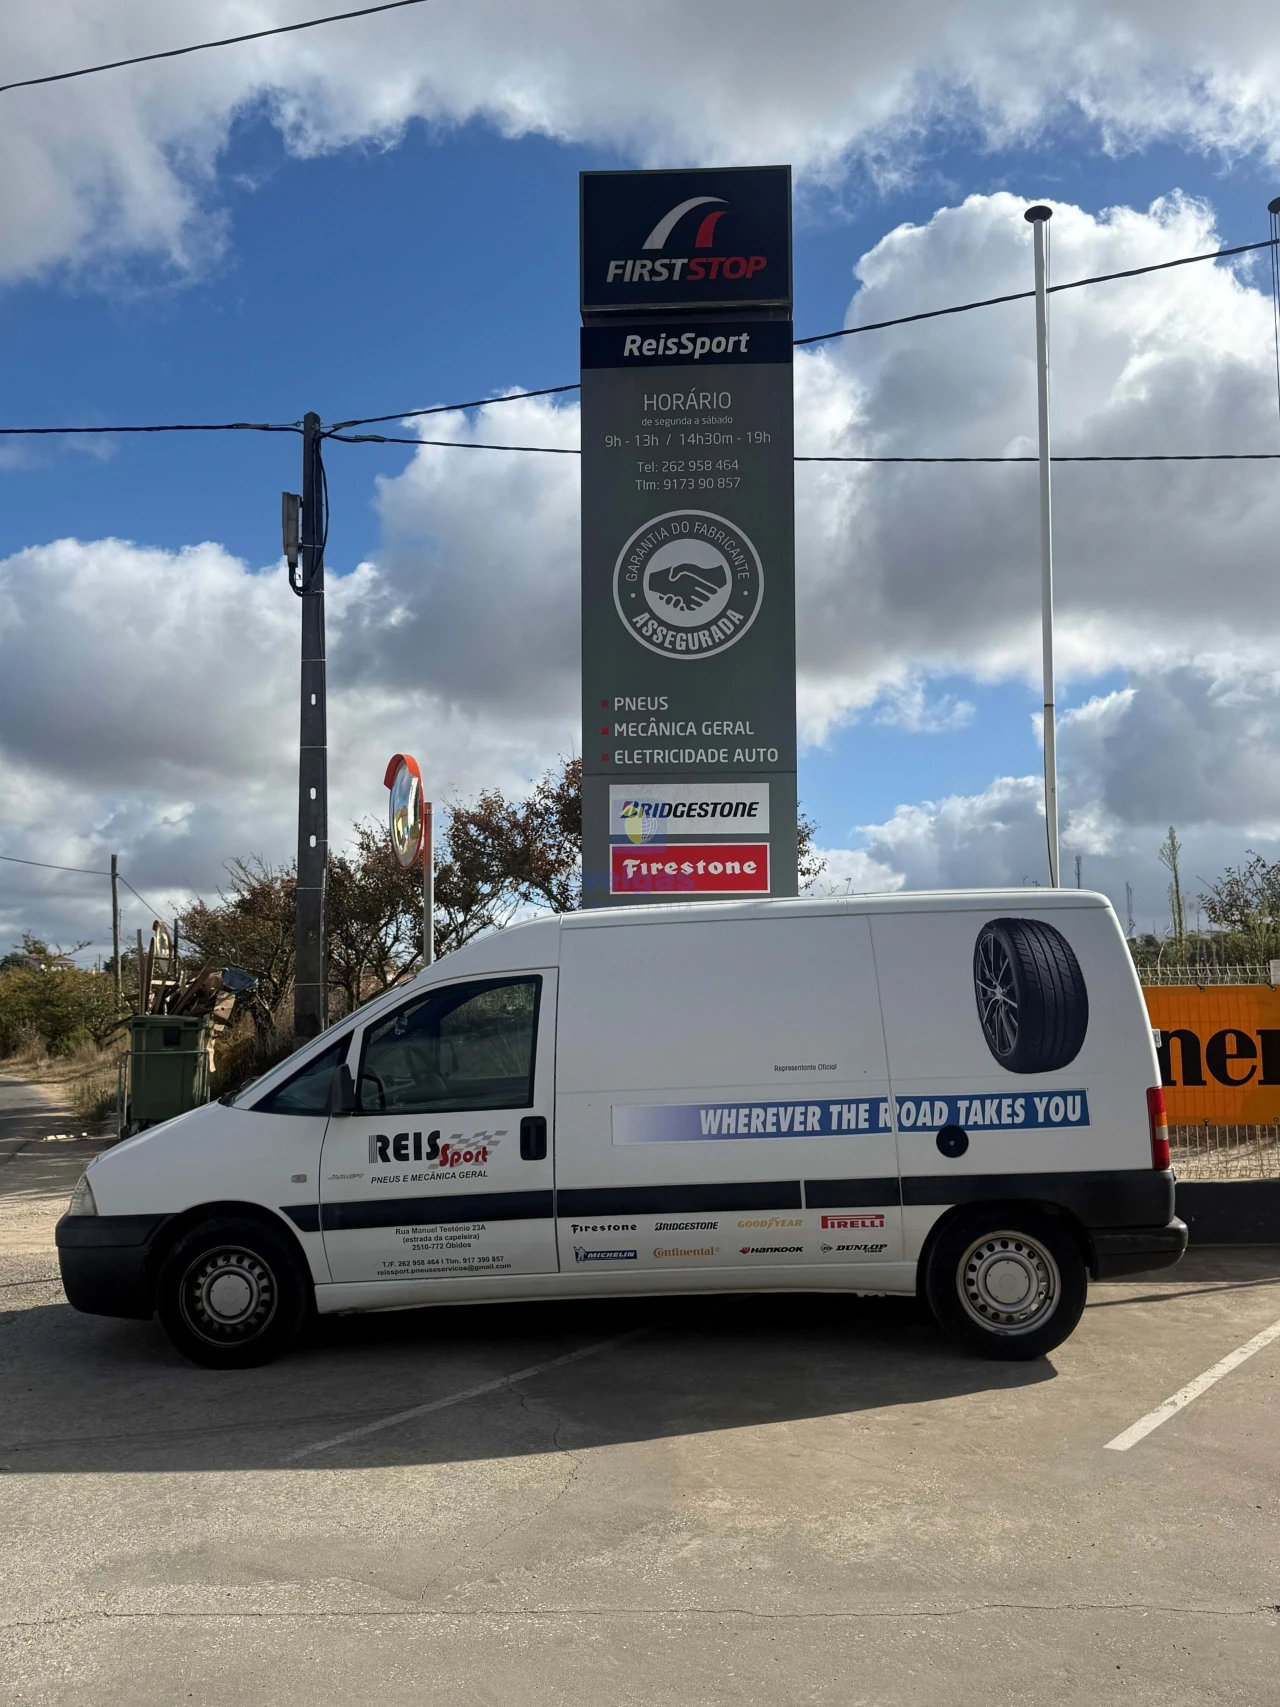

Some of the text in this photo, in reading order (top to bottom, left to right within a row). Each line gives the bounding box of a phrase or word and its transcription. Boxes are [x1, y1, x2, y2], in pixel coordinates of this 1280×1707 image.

[623, 332, 750, 359] ReisSport
[643, 387, 732, 412] HORÁRIO
[641, 415, 733, 428] de segunda a sábado
[604, 435, 622, 448] 9h
[634, 434, 659, 447] 13h
[665, 433, 672, 446] /
[679, 432, 733, 446] 14h30m
[746, 431, 771, 444] 19h
[636, 459, 739, 473] Tel: 262 958 464
[635, 477, 741, 491] Tlm: 9173 90 857
[625, 521, 750, 582] GARANTIA DO FABRICANTE
[632, 609, 745, 651] ASSEGURADA
[614, 696, 669, 711] PNEUS
[614, 717, 754, 737] MECÂNICA GERAL
[614, 748, 779, 764] ELETRICIDADE AUTO
[620, 800, 760, 819] BRIDGESTONE
[622, 858, 757, 880] Firestone
[774, 1063, 837, 1073] Representante Oficial
[700, 1095, 1082, 1135] WHEREVER THE ROAD TAKES YOU
[368, 1130, 441, 1164] REIS
[439, 1143, 489, 1168] Sport
[371, 1170, 489, 1184] PNEUS E MECÂNICA GERAL
[571, 1223, 637, 1234] Firestone
[654, 1221, 719, 1231] BRIDGESTONE
[737, 1216, 803, 1229] GOODYEAR
[821, 1214, 885, 1229] PIRELLI
[411, 1226, 438, 1234] Manuel
[402, 1236, 432, 1244] (estrada
[444, 1233, 480, 1243] capeleira)
[412, 1241, 472, 1251] 2510-772 Óbidos
[653, 1247, 715, 1258] Continental
[835, 1243, 888, 1251] DUNLOP
[412, 1259, 425, 1267] 958
[426, 1258, 440, 1266] 464
